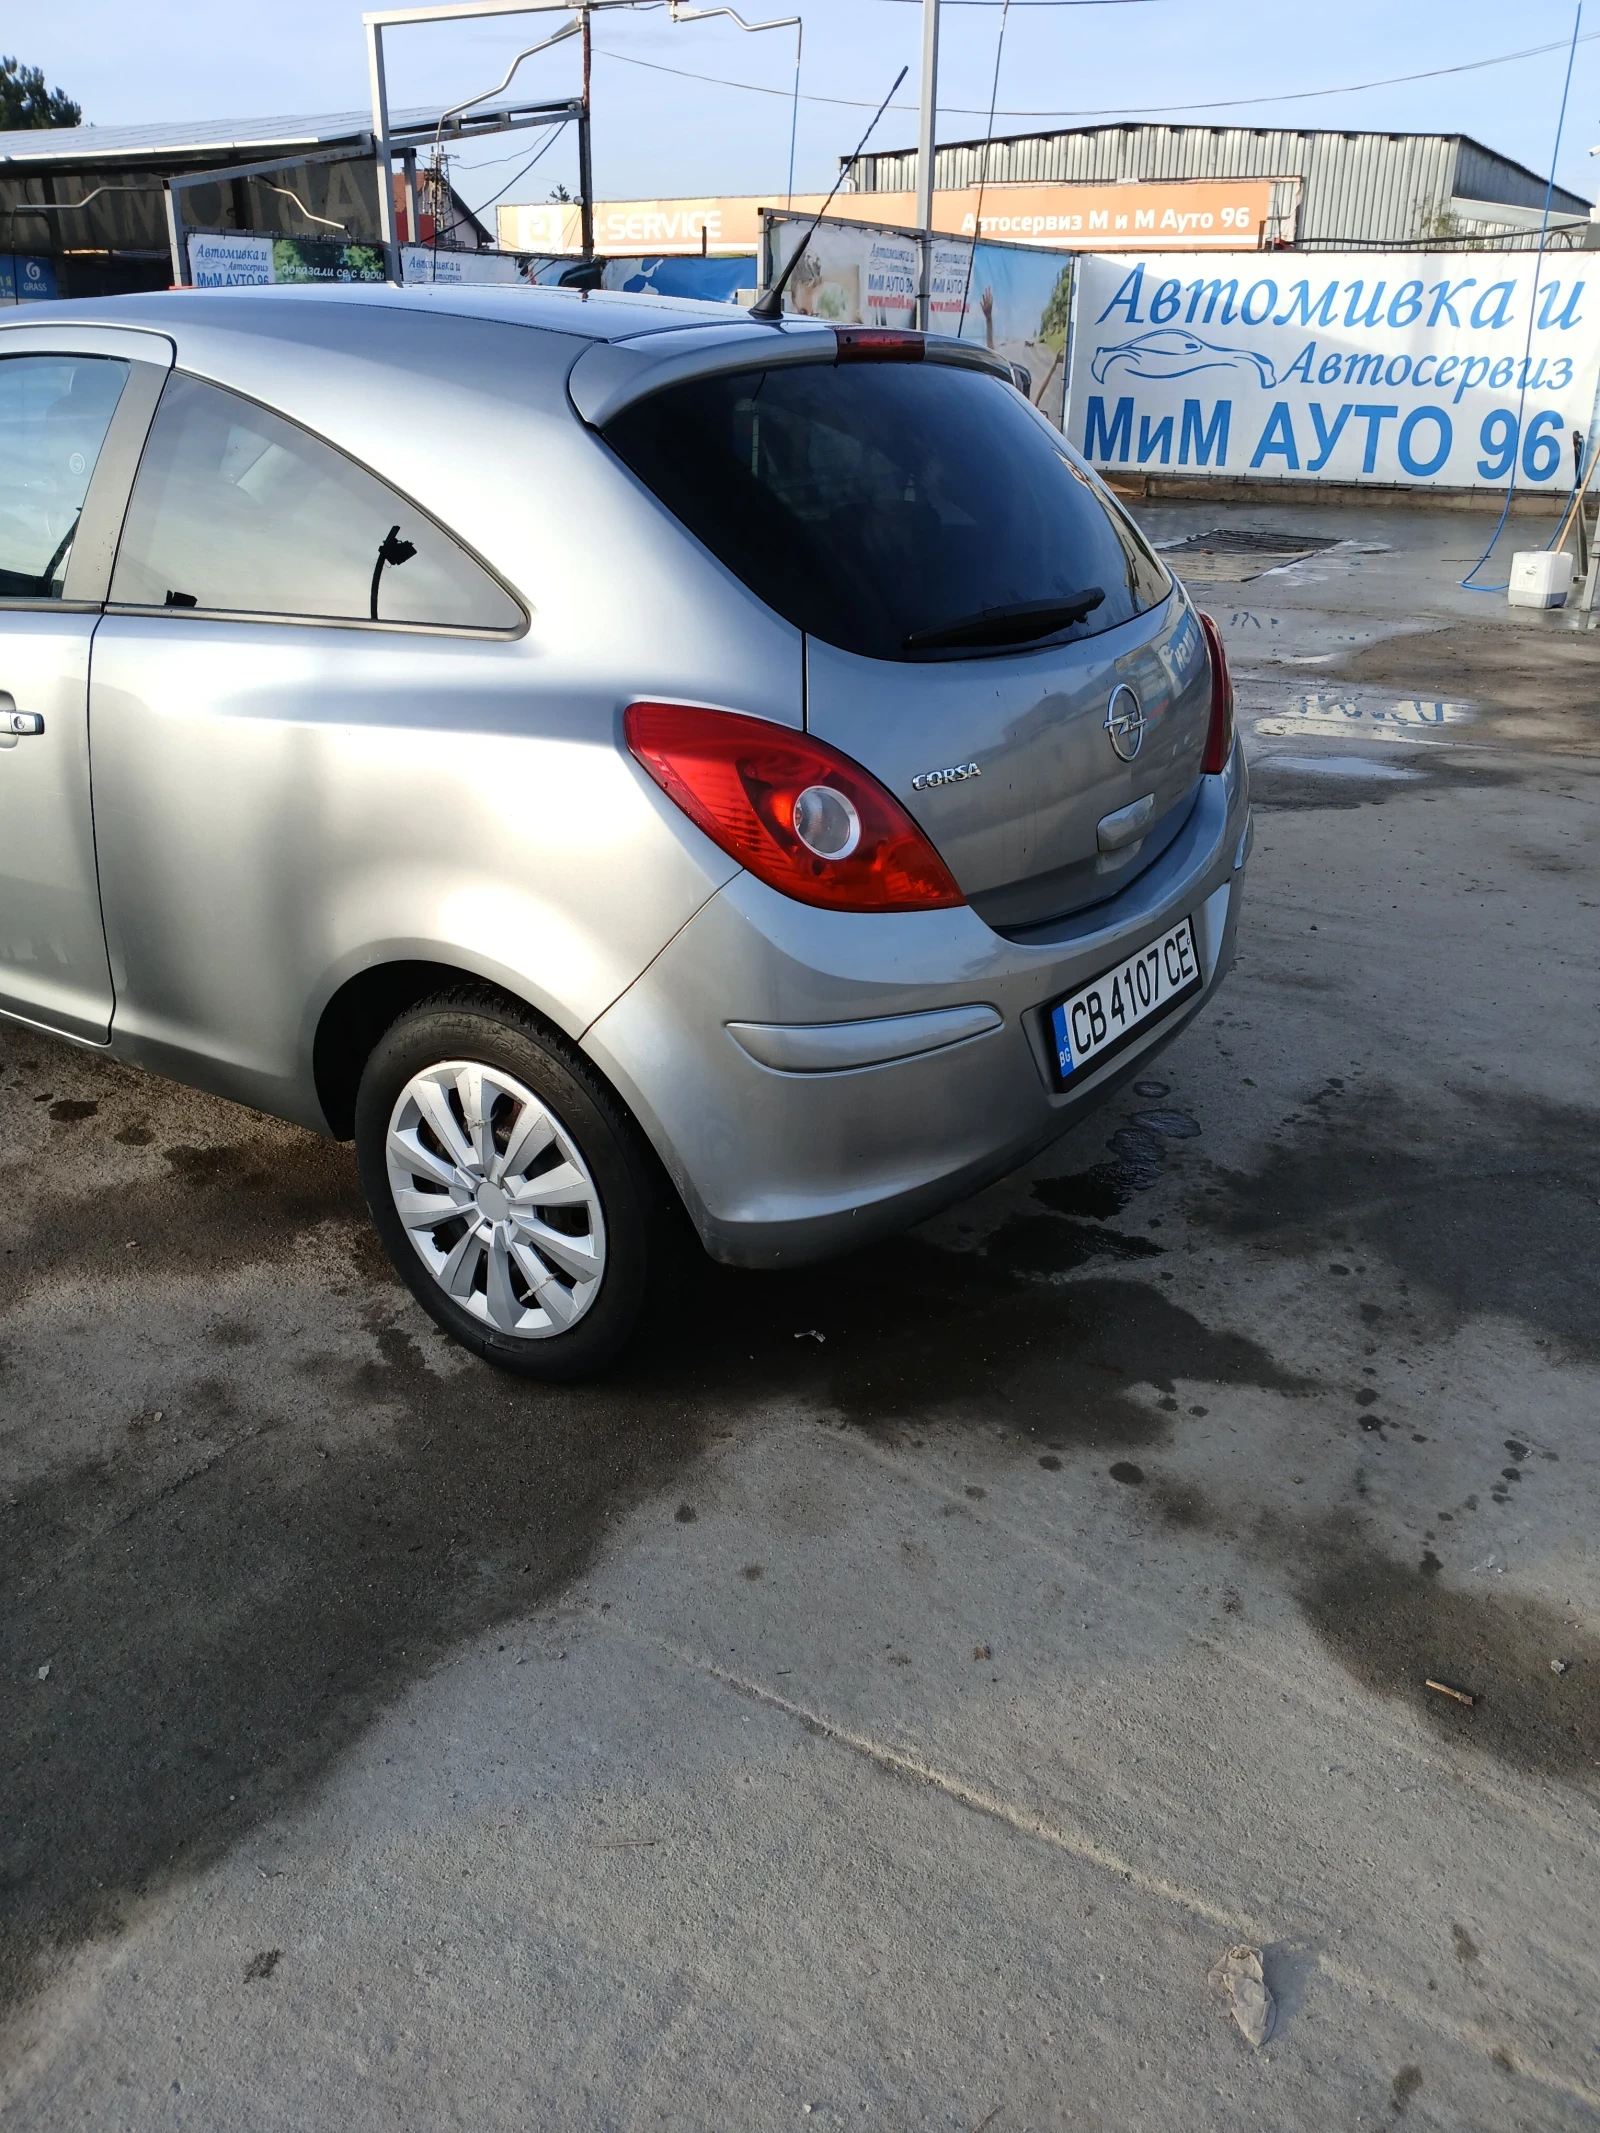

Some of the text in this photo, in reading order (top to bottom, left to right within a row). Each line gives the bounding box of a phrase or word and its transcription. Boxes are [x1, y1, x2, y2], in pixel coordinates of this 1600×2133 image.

[961, 207, 1250, 235] Автосервиз М и М Ауто 96
[196, 244, 268, 261] Автомивка и
[23, 282, 48, 292] GRASS
[337, 268, 349, 279] се
[886, 275, 905, 293] АУТО
[1095, 262, 1587, 330] Автомивка и
[1277, 341, 1574, 404] Автосервиз
[1083, 396, 1565, 482] МиМ АУТО 96
[912, 762, 981, 791] CORSA
[1071, 928, 1193, 1055] CB 4107 CE
[1059, 1047, 1071, 1067] BG
